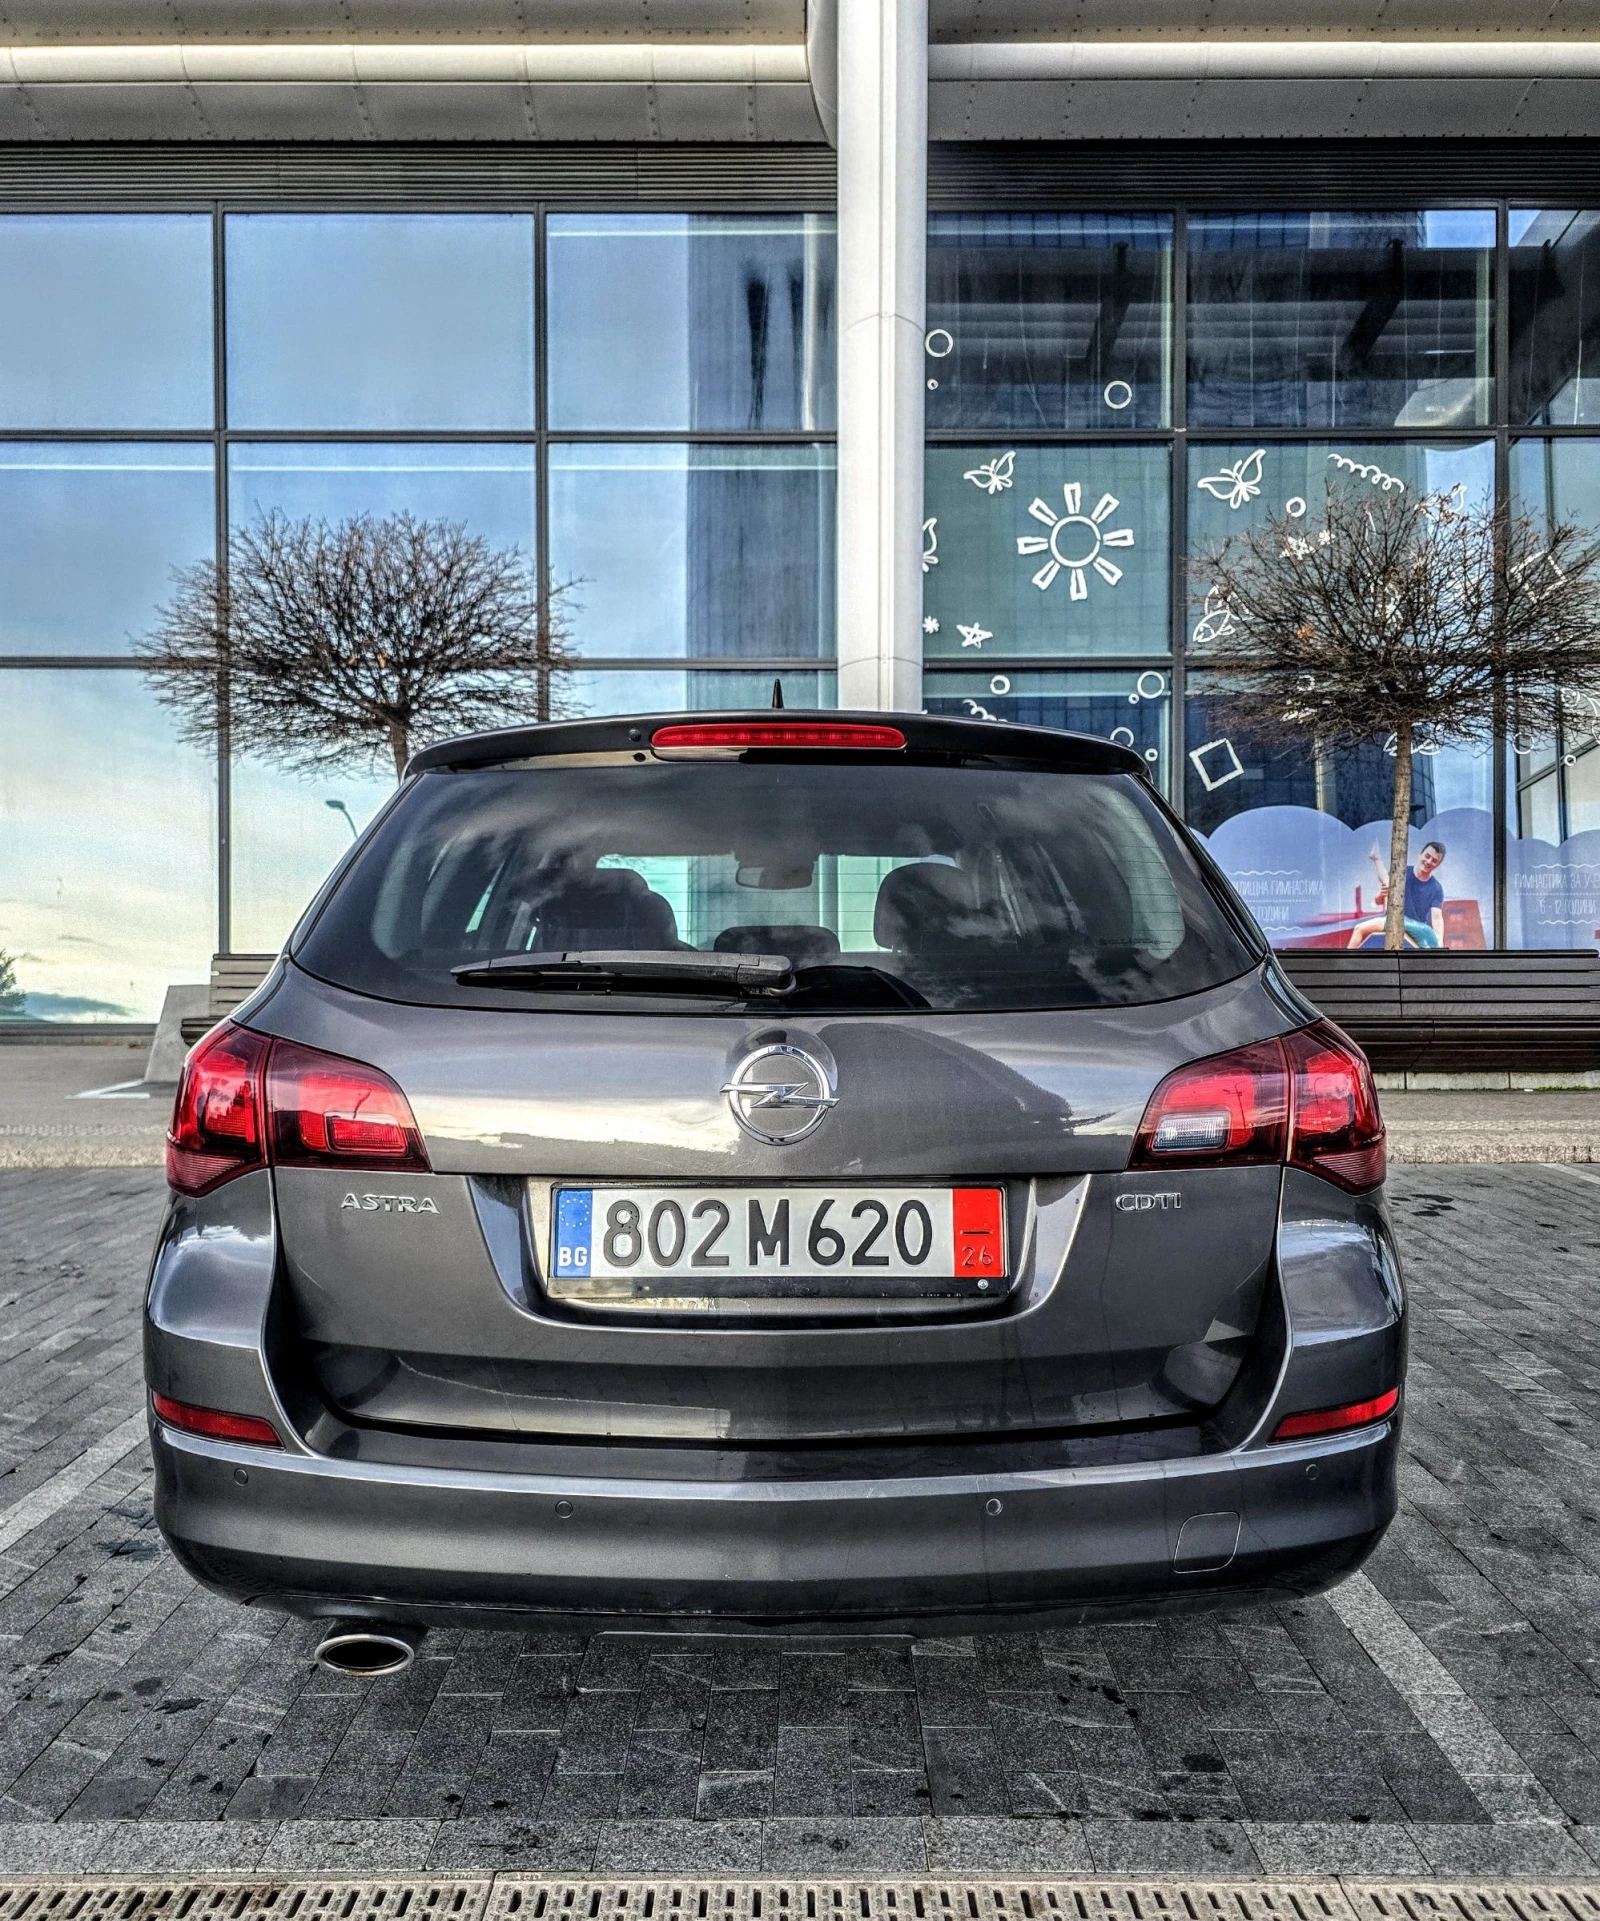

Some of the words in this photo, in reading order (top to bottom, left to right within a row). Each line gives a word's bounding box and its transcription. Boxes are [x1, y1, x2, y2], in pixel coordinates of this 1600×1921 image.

[340, 1192, 440, 1215] ASTRA
[1115, 1192, 1181, 1212] CDTI
[603, 1199, 731, 1268] 802
[748, 1199, 790, 1267] M
[807, 1199, 933, 1268] 620
[558, 1246, 588, 1268] BG
[961, 1245, 994, 1268] 26
